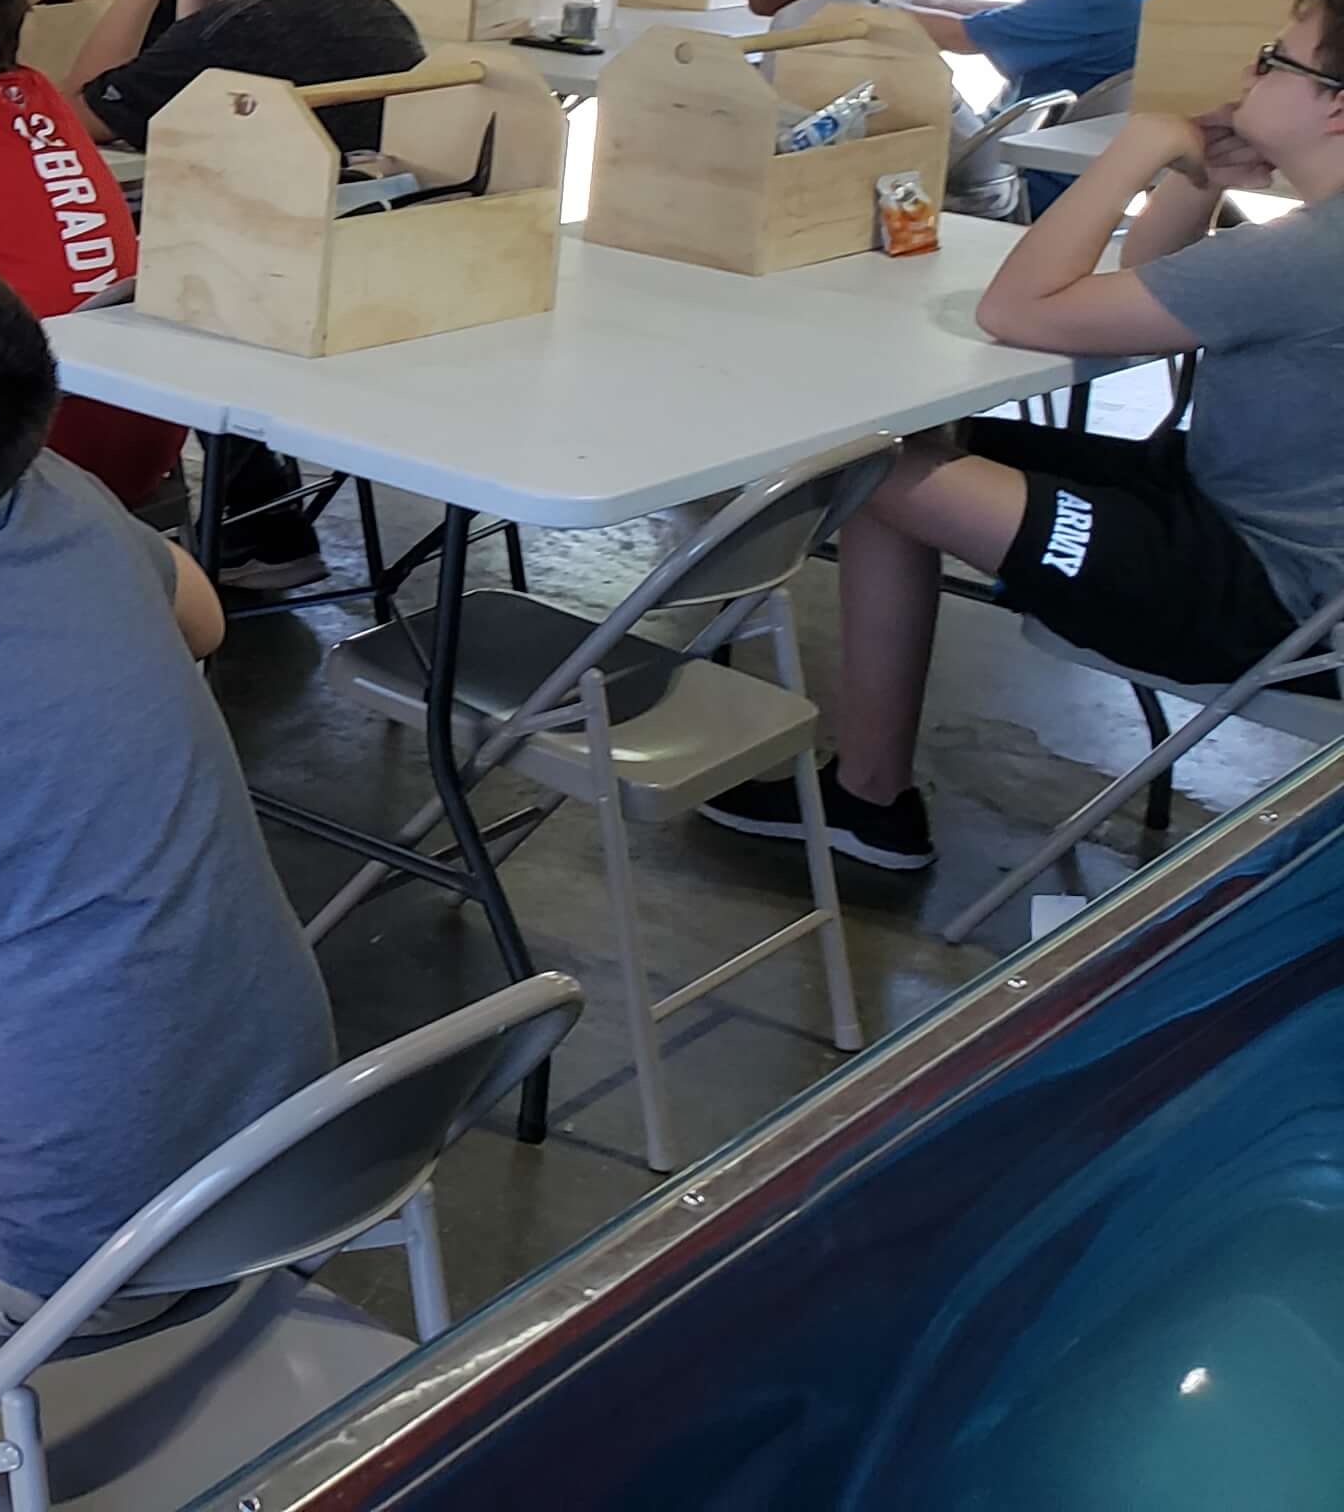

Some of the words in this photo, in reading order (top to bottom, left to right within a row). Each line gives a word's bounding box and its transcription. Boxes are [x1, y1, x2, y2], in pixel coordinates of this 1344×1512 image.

[13, 112, 68, 151] 12
[32, 149, 118, 294] BRADY
[1041, 489, 1093, 578] ARMY
